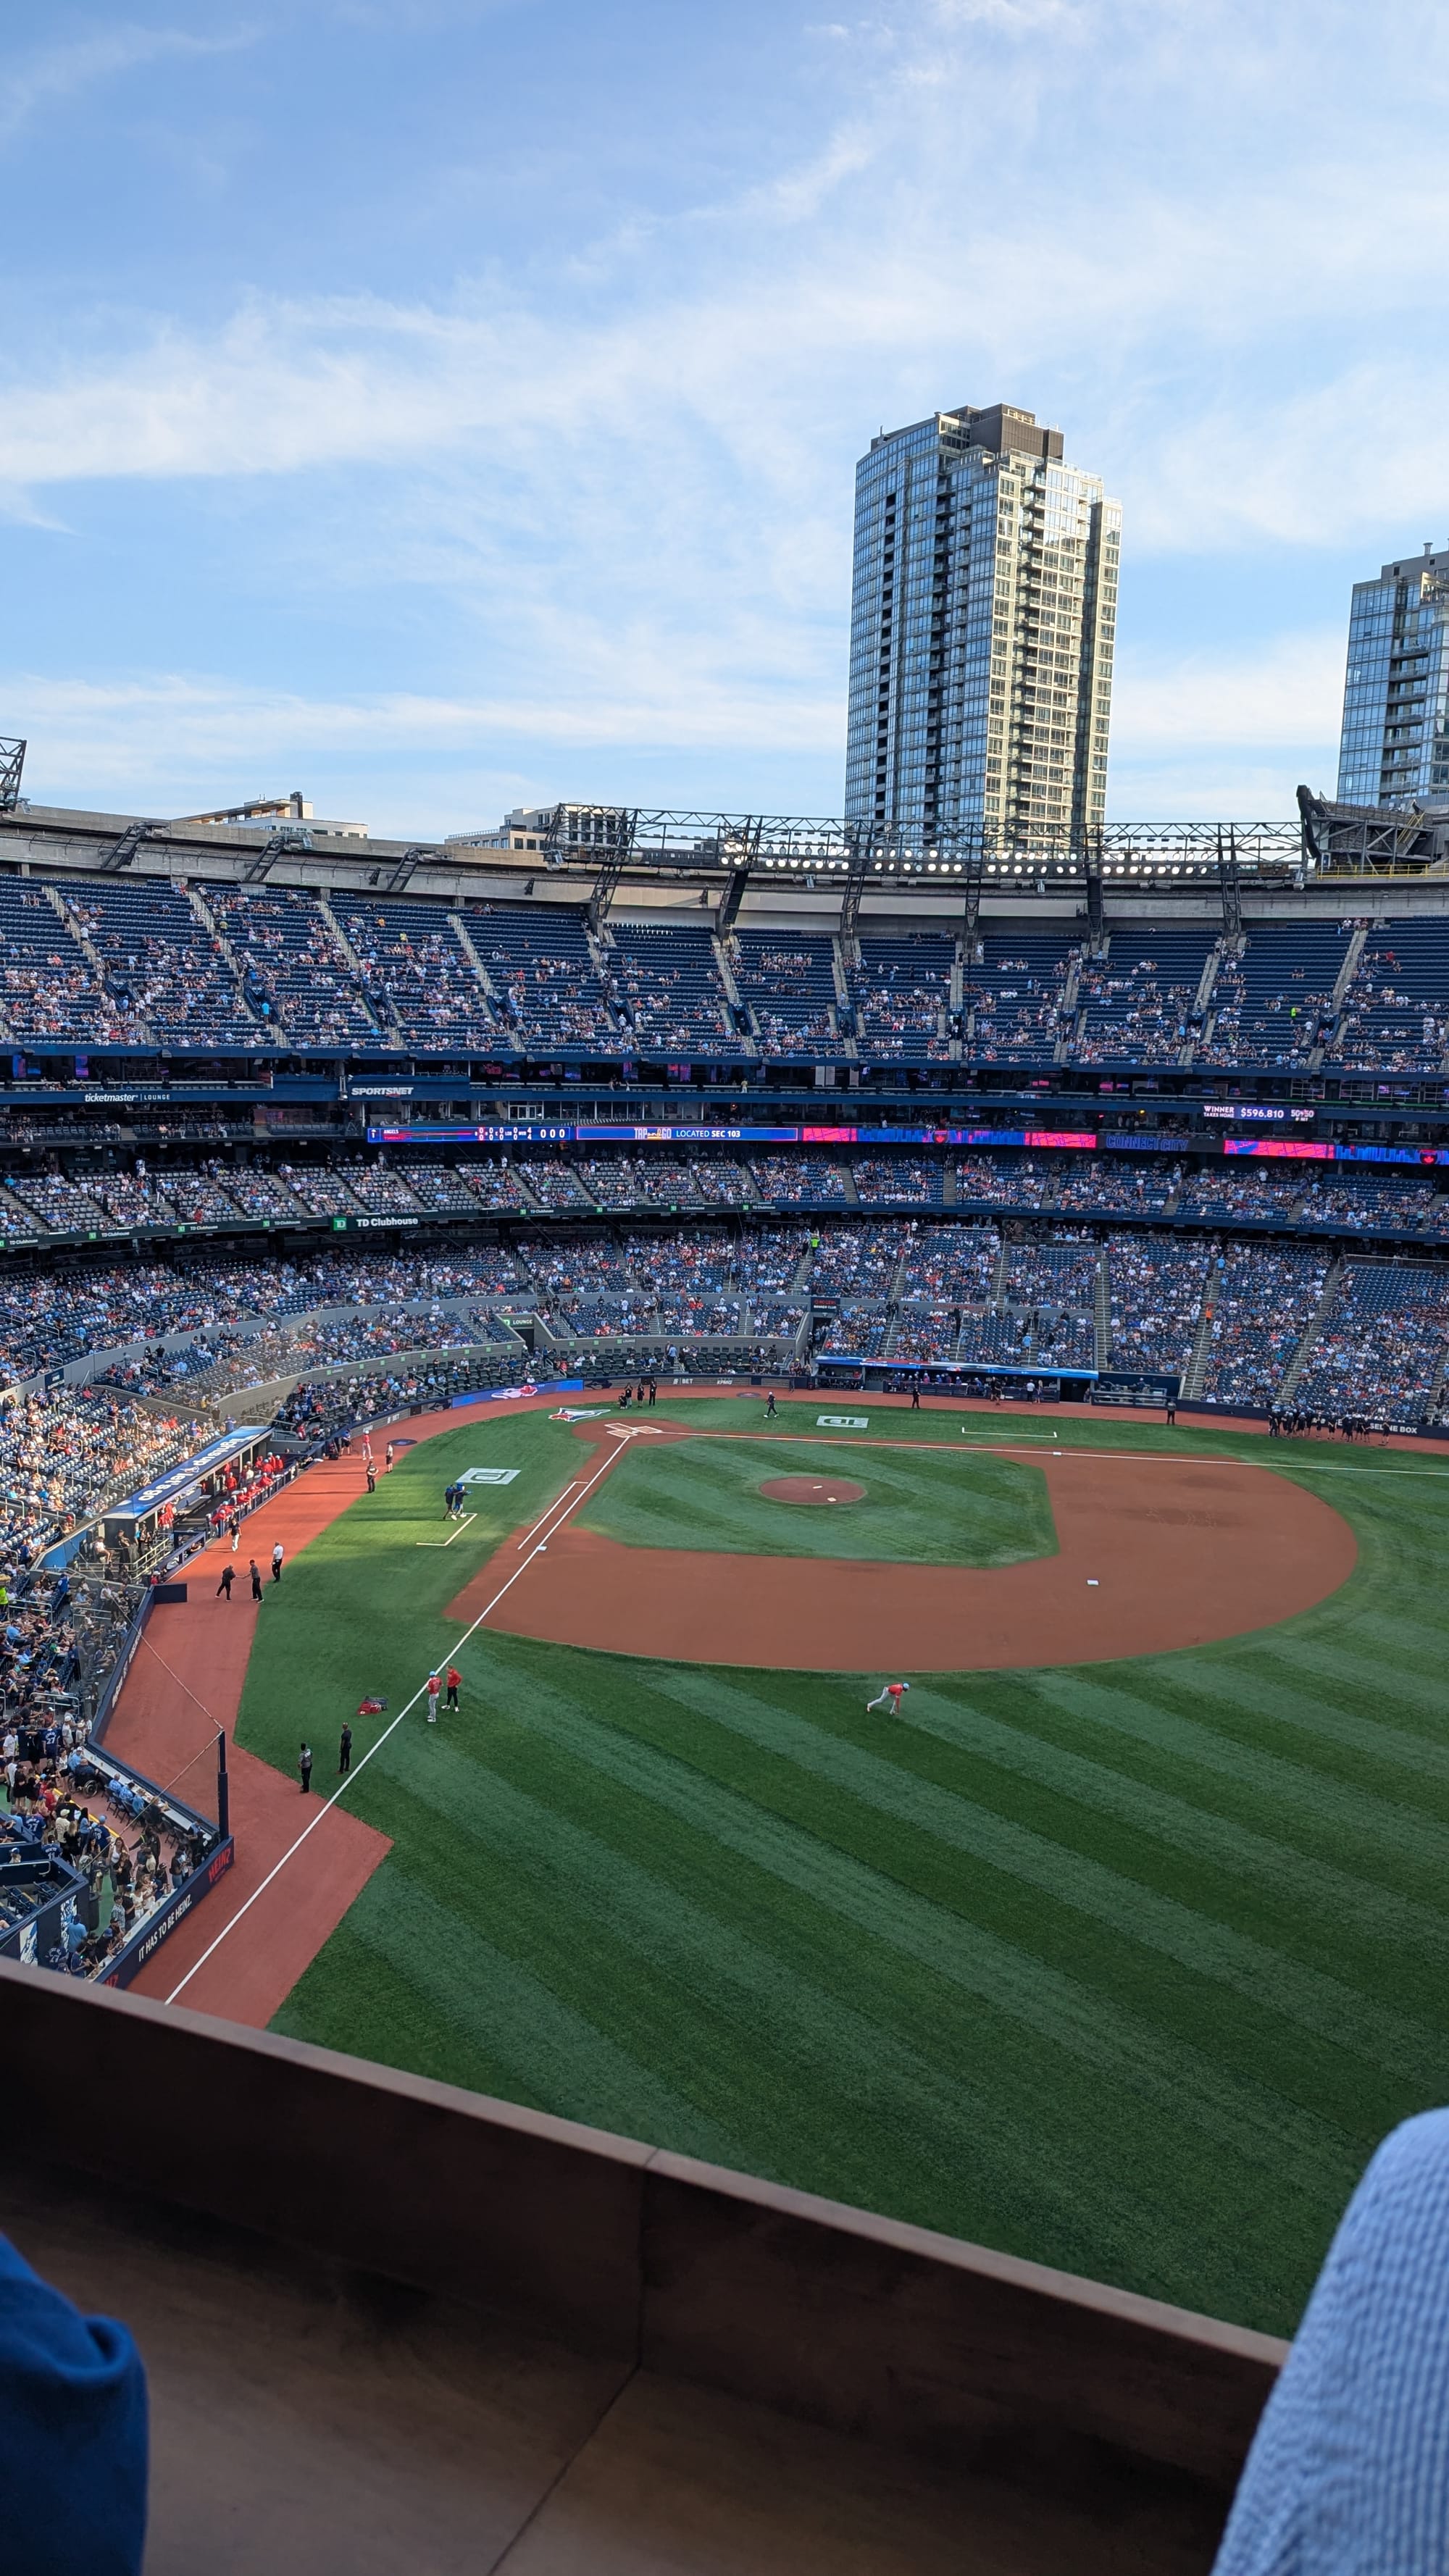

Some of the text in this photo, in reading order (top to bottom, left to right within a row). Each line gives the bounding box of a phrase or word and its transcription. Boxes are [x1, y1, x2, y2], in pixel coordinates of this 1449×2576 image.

[540, 1129, 565, 1139] 0 0 0
[1161, 1139, 1188, 1151] CITY
[334, 1219, 346, 1229] TD
[356, 1218, 418, 1227] TD Clubhouse
[209, 1847, 231, 1883] HEINZ
[138, 1946, 145, 1962] IT
[146, 1931, 158, 1954] HAS
[159, 1921, 167, 1939] TO
[167, 1912, 175, 1930] BE
